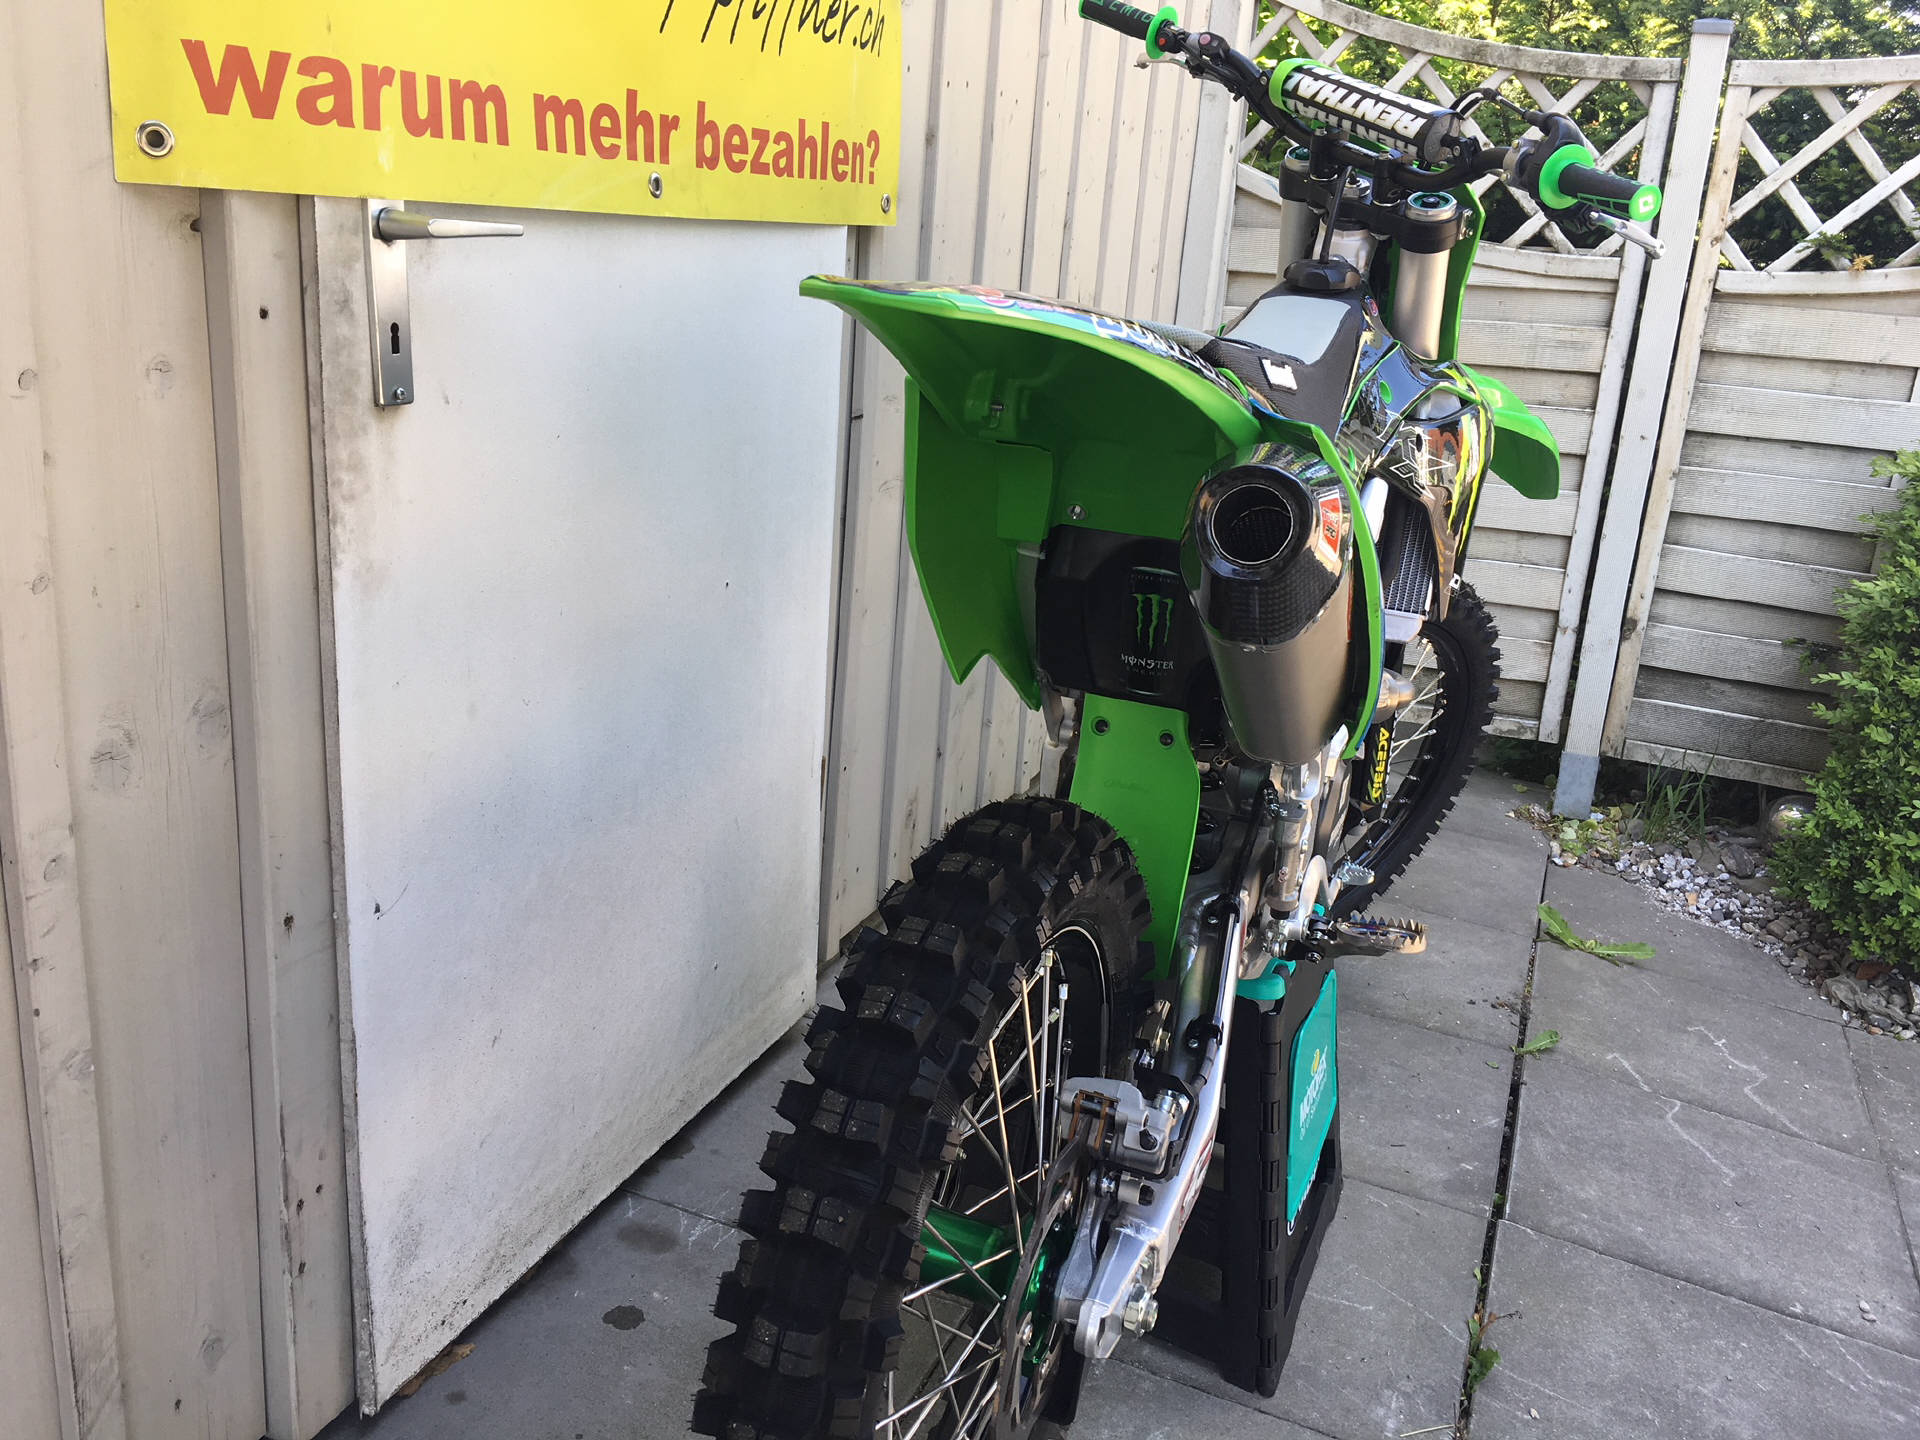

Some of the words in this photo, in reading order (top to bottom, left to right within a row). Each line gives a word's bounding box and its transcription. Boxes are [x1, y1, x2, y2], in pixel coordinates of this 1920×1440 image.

[181, 39, 510, 147] warum
[534, 88, 681, 165] mehr
[696, 101, 881, 183] bezahlen?
[1283, 72, 1428, 139] RENTHAL
[1121, 653, 1174, 670] MONSTER
[1372, 727, 1390, 799] ACERBIS
